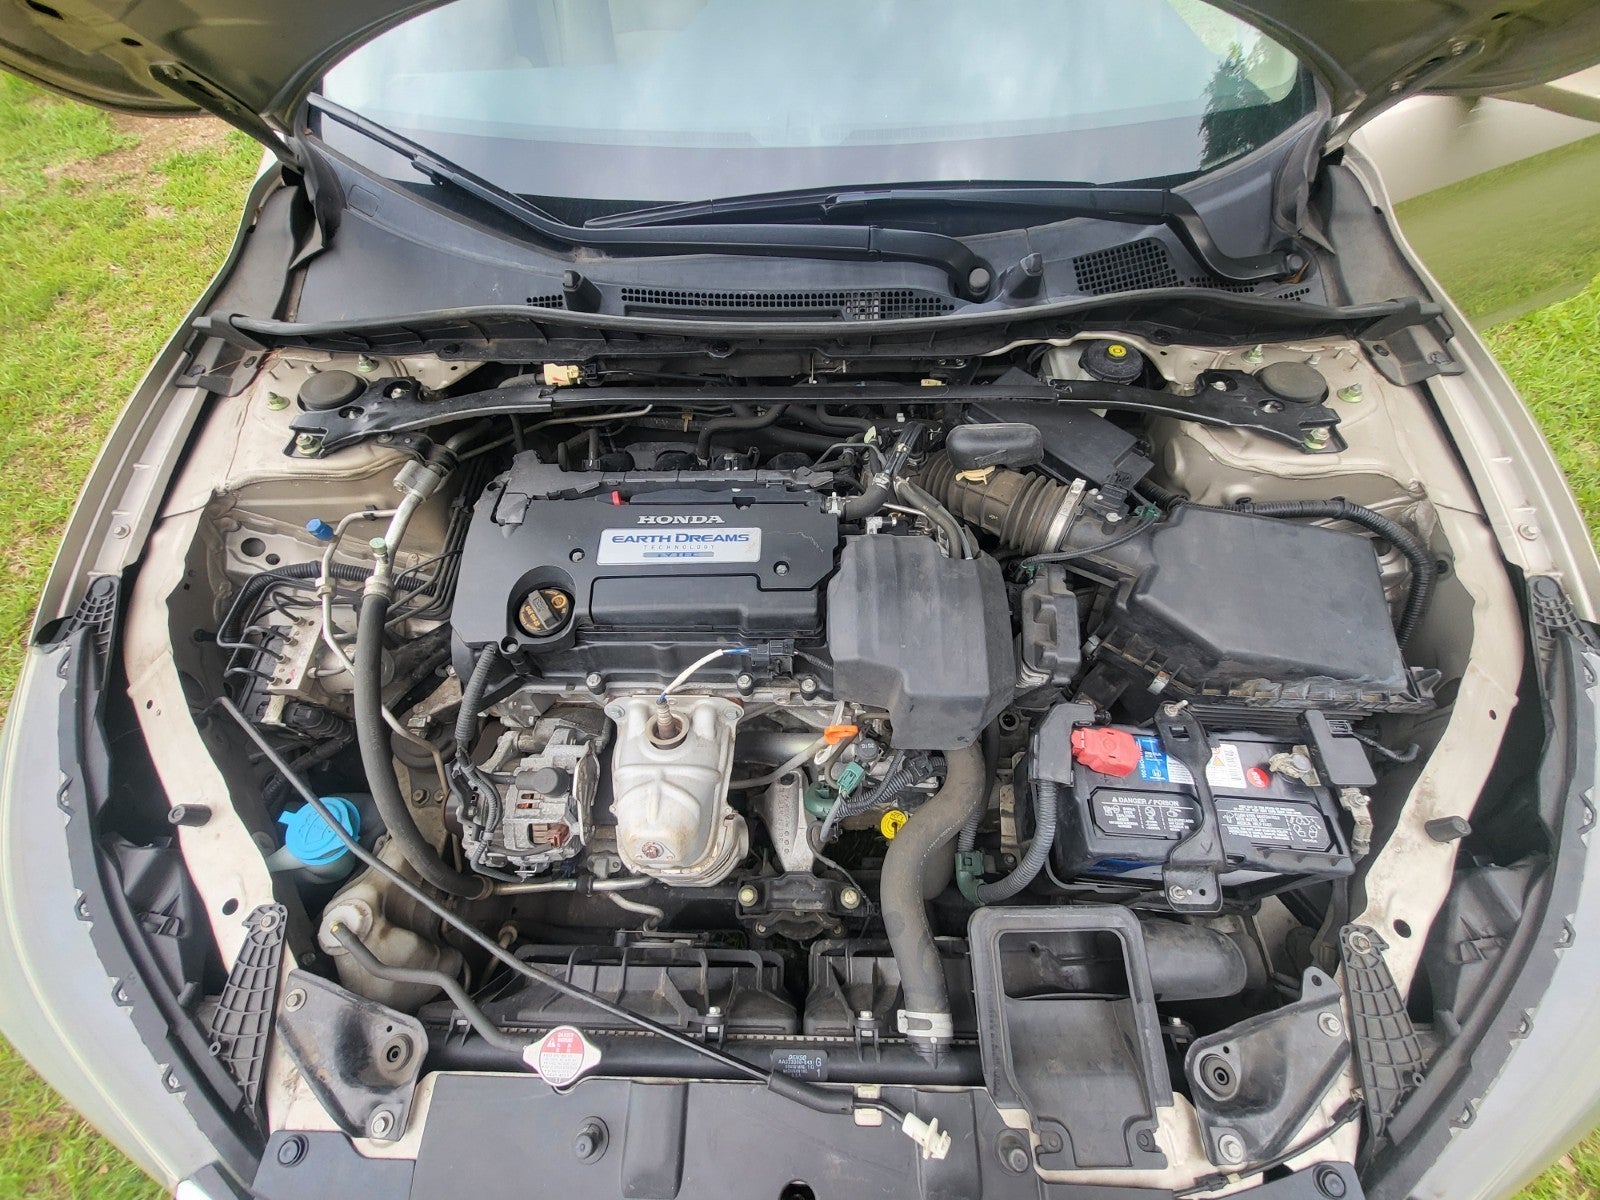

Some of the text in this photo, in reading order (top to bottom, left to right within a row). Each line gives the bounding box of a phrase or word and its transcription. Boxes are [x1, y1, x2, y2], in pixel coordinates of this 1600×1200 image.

[637, 515, 725, 524] HONDA
[612, 533, 749, 543] EARTH DREAMS
